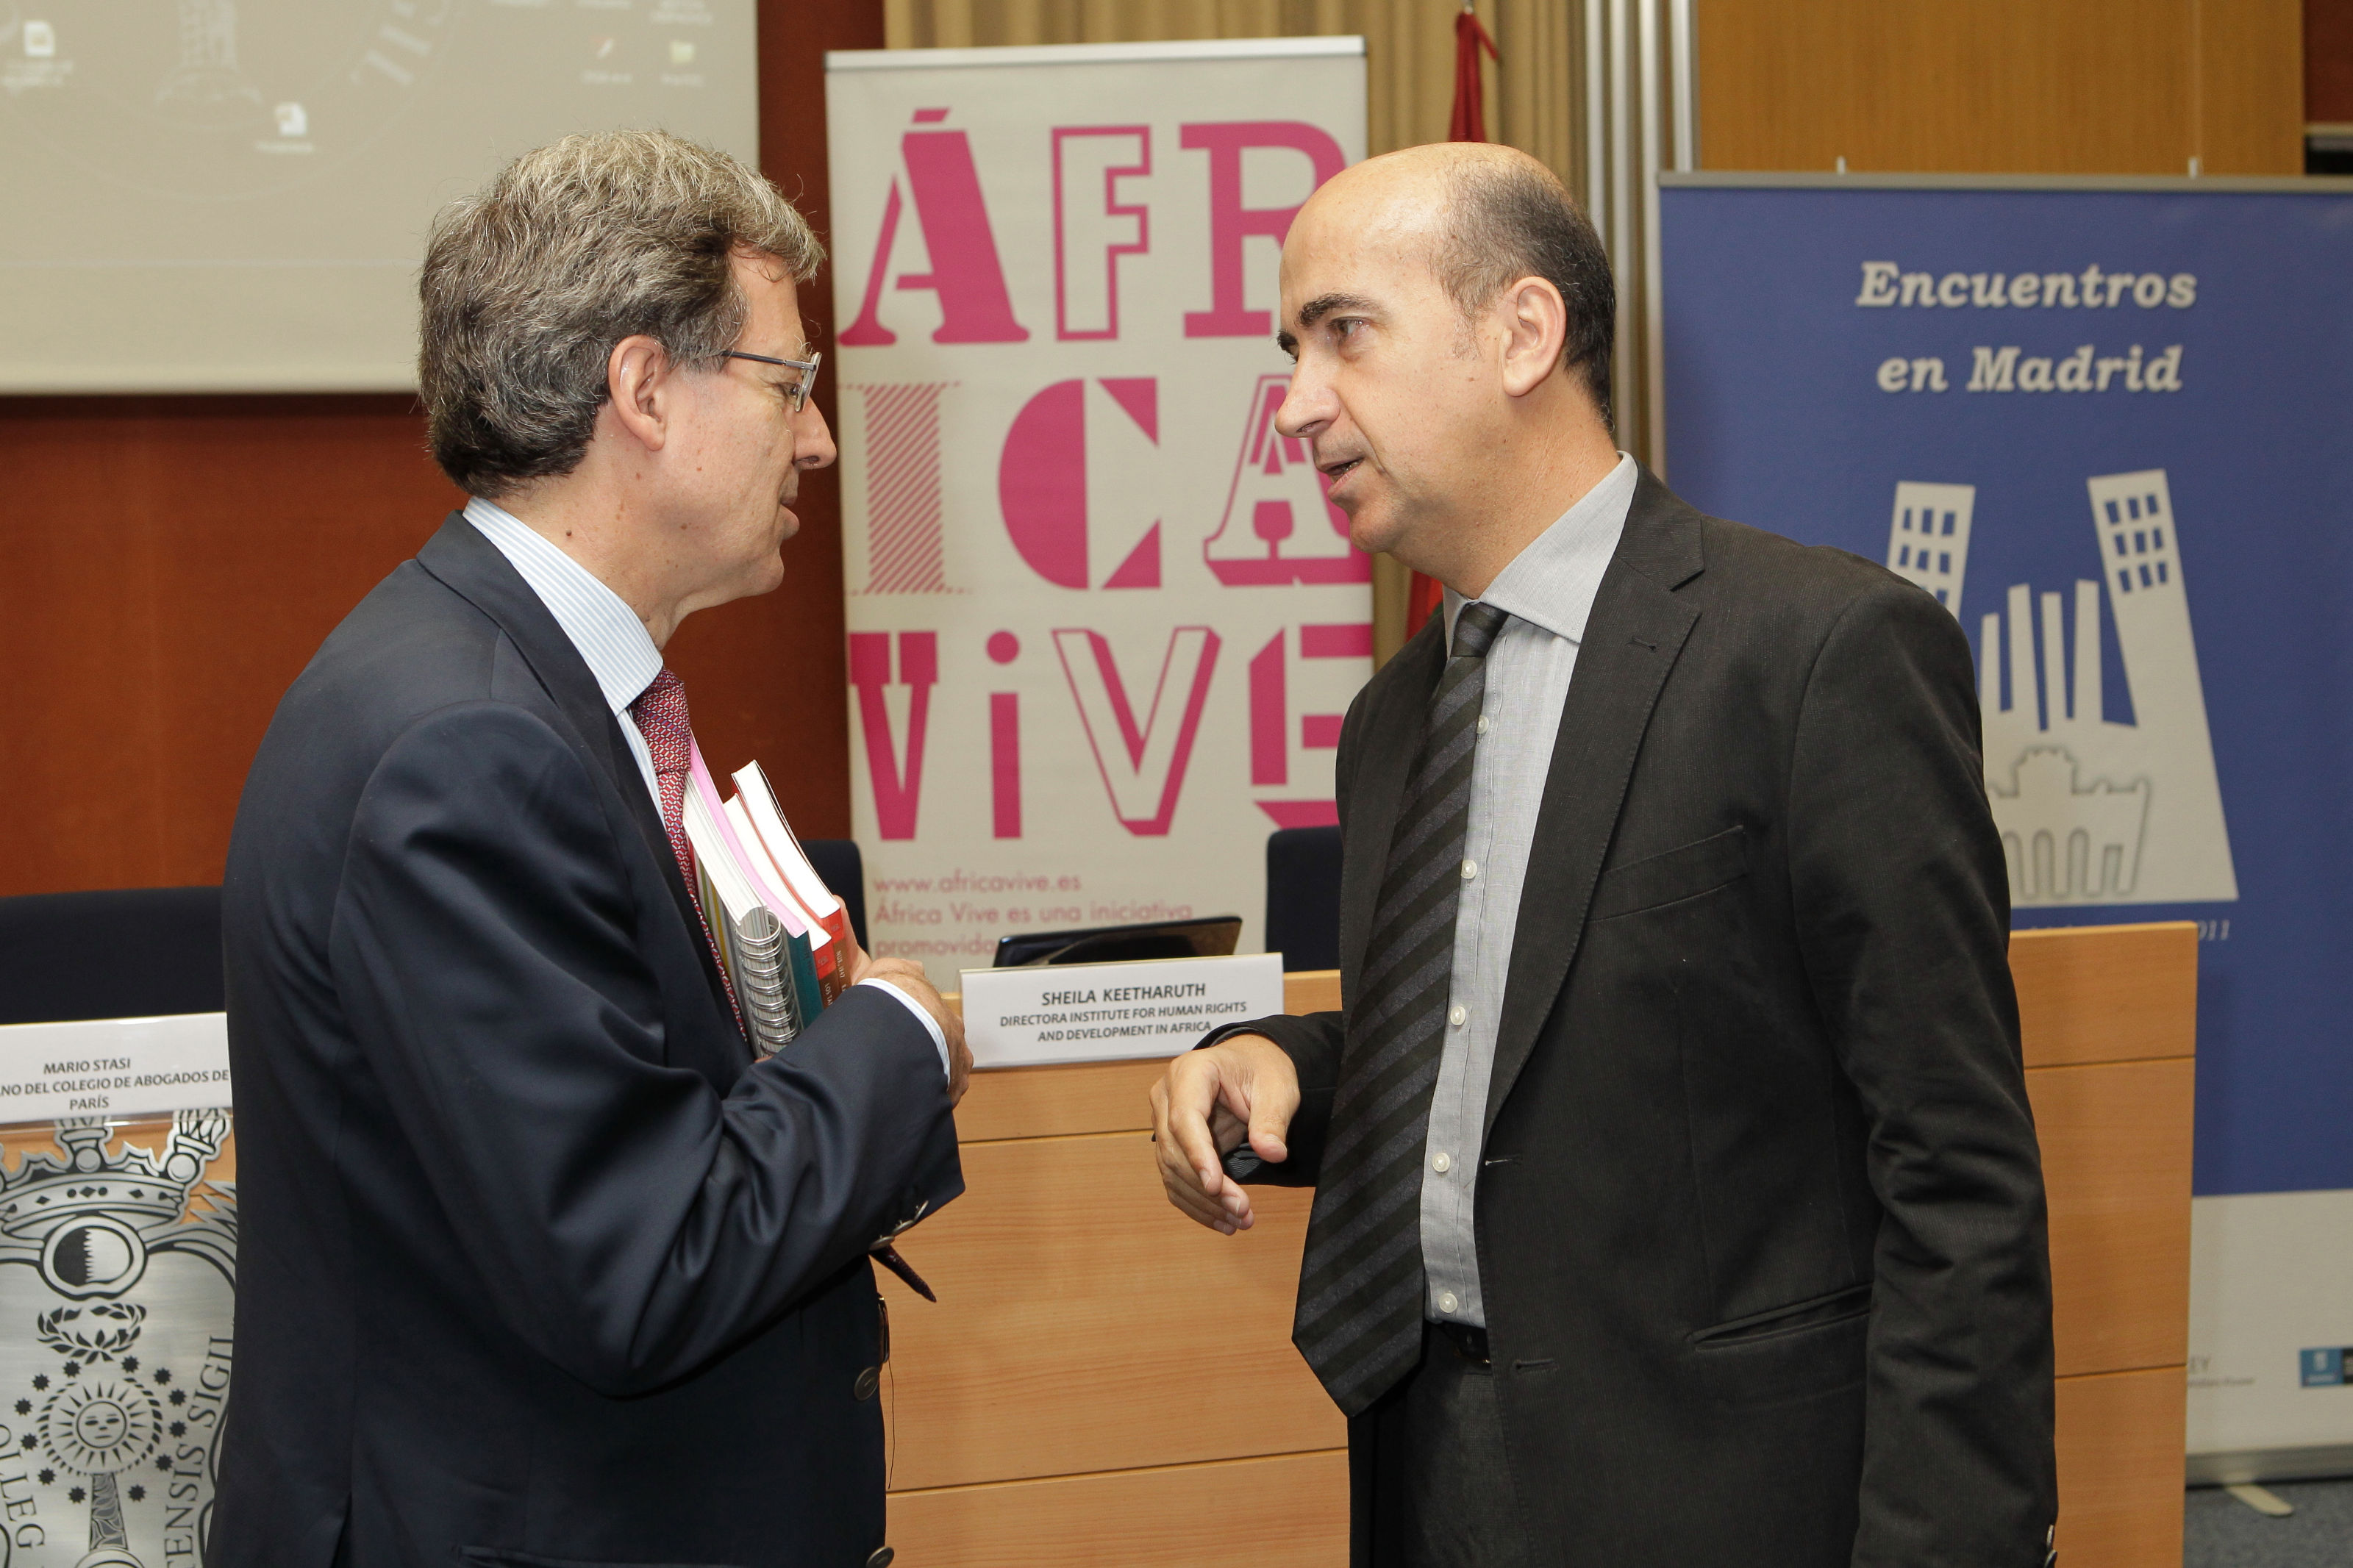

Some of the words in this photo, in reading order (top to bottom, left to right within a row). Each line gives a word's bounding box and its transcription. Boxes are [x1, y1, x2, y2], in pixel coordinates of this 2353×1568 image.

[1855, 260, 2198, 309] Encuentros
[1876, 355, 1949, 393] en
[1965, 343, 2184, 393] Madrid
[874, 867, 1082, 892] www.africavive.es
[875, 897, 942, 925] África
[949, 901, 1000, 923] Vive
[1007, 907, 1031, 923] es
[1038, 906, 1082, 923] una
[1089, 899, 1193, 921] iniciativa
[1041, 989, 1096, 1006] SHEILA
[1103, 983, 1205, 1002] KEETHARUTH
[1000, 1013, 1067, 1027] DIRECTORA
[1070, 1009, 1130, 1023] INSTITUTE
[1132, 1007, 1155, 1018] FOR
[1158, 1004, 1202, 1017] HUMAN
[1205, 1001, 1247, 1014] RIGHTS
[1038, 1030, 1064, 1042] AND
[1066, 1024, 1153, 1040] DEVELOPMENT
[1156, 1024, 1168, 1034] IN
[1169, 1021, 1211, 1034] AFRICA
[43, 1061, 90, 1074] MARIO
[93, 1058, 130, 1071] STASI
[0, 1084, 21, 1096] NO
[25, 1083, 49, 1094] DEL
[52, 1078, 110, 1092] COLEGIO
[114, 1076, 131, 1088] DE
[134, 1070, 209, 1087] ABOGADOS
[213, 1070, 229, 1081] DE
[69, 1094, 109, 1110] PARÍS
[164, 1443, 206, 1568] ENSIS
